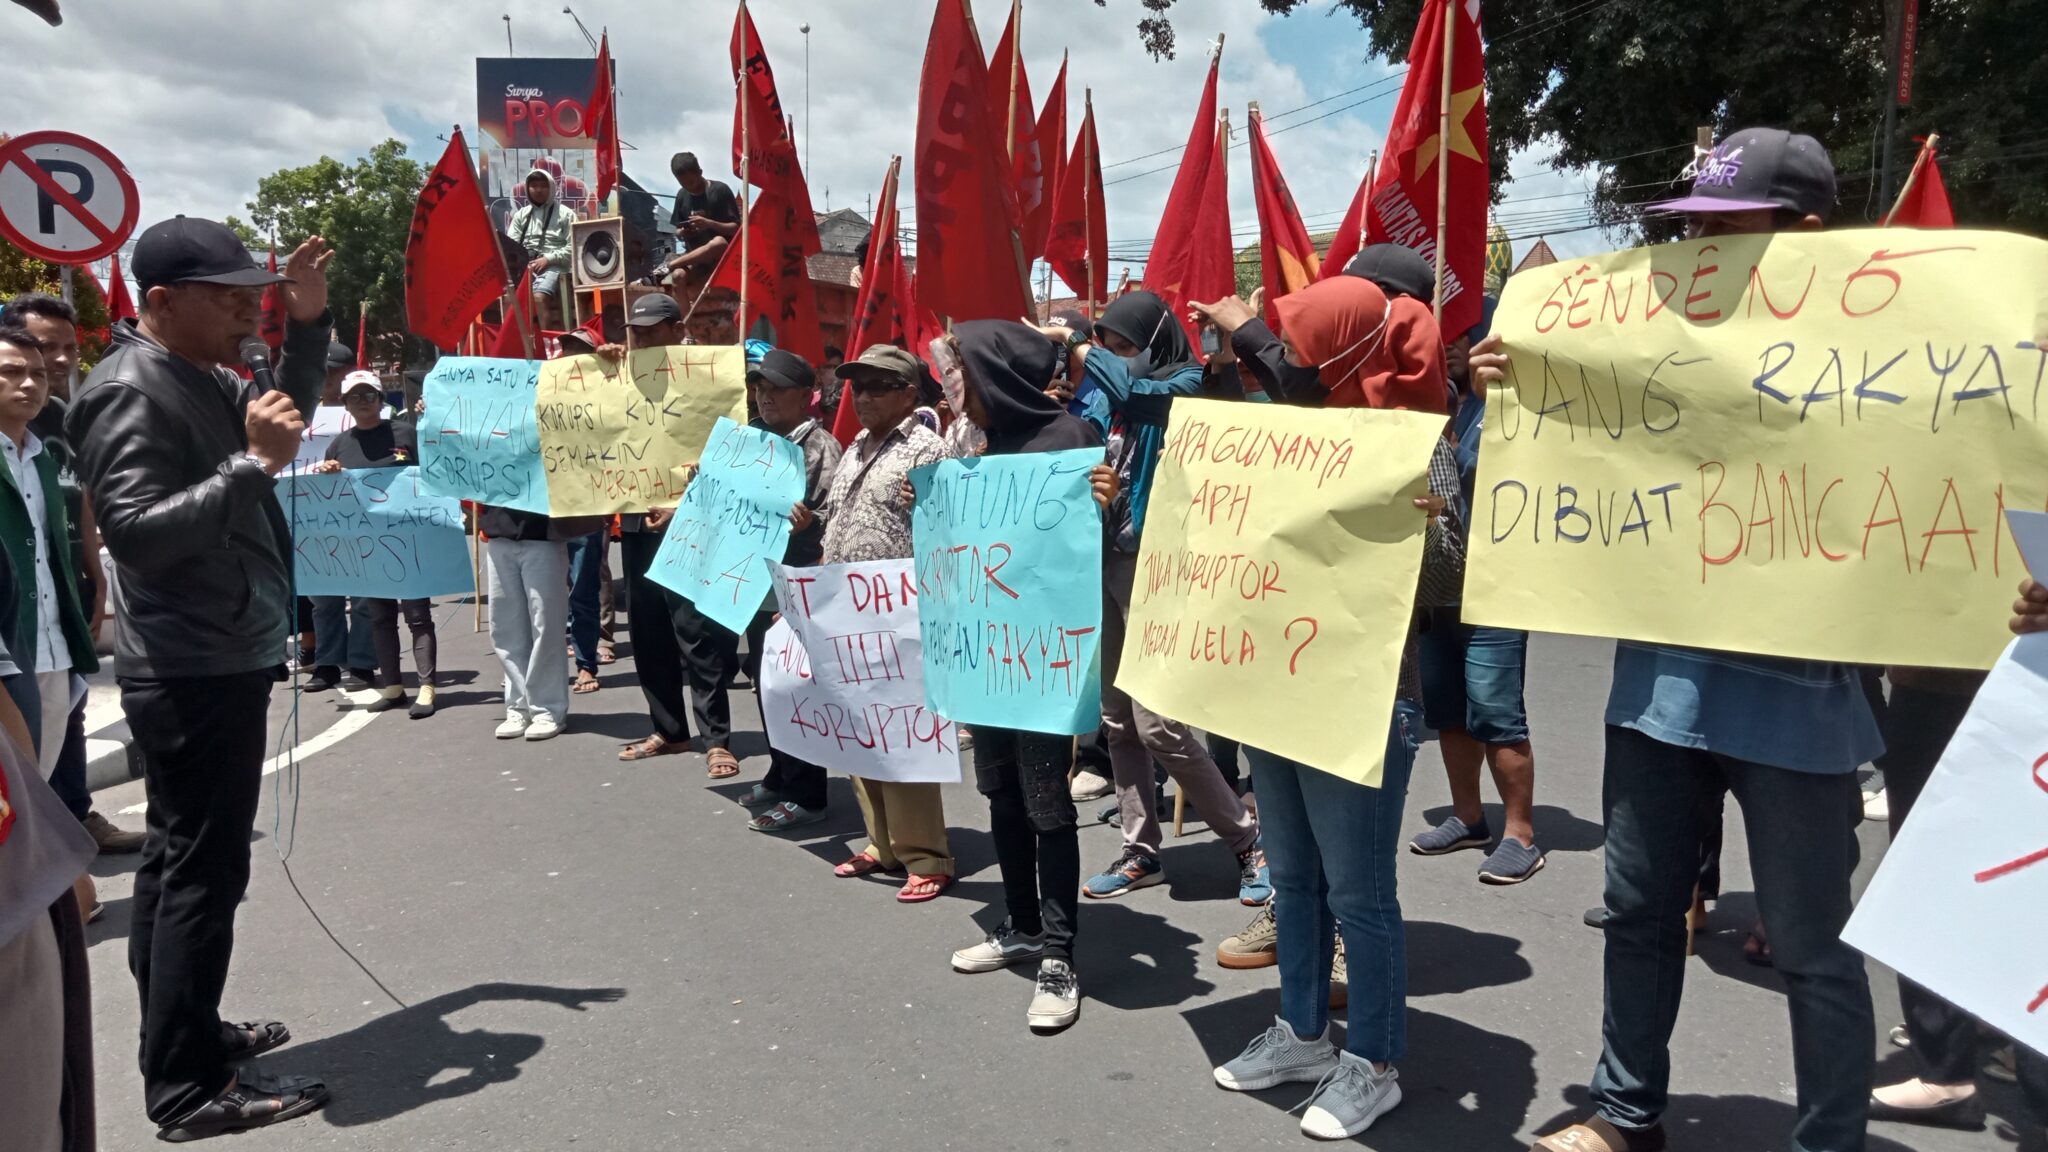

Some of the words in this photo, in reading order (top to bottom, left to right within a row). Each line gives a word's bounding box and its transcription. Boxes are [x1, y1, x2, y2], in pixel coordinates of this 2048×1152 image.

[505, 84, 543, 101] Surya
[36, 158, 94, 234] P
[487, 367, 518, 388] SATU
[549, 359, 585, 394] YA
[625, 393, 682, 427] KOK
[426, 455, 531, 502] KORUPSI
[545, 437, 652, 473] SEMAKIN
[1181, 479, 1251, 535] APH
[1491, 479, 1682, 547] DIBUAT
[985, 620, 1096, 699] RAKYAT
[1190, 620, 1256, 666] LELA
[1284, 616, 1318, 676] ?
[790, 692, 954, 754] KORUPTOR
